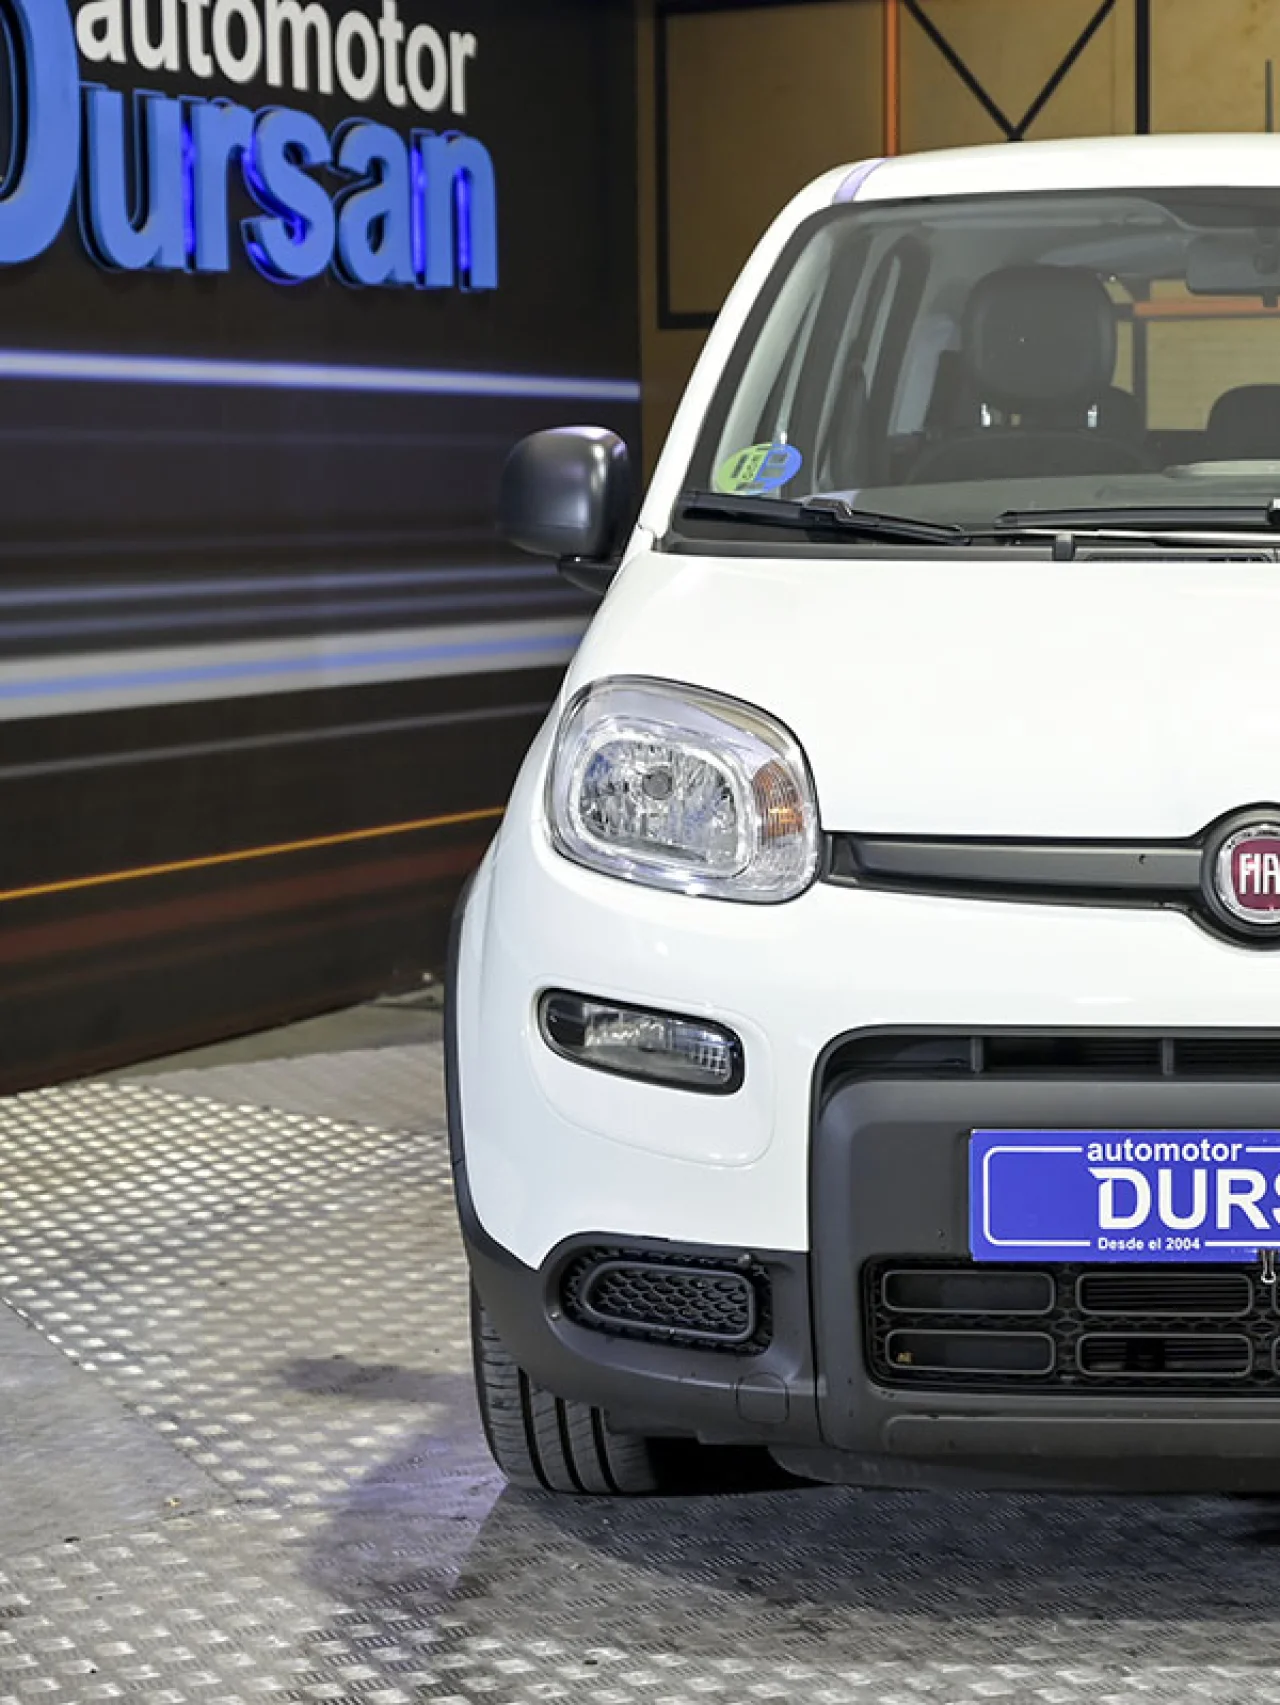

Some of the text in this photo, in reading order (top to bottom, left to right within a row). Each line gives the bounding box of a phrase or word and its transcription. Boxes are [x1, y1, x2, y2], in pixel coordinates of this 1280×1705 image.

[76, 0, 477, 115] automotor
[1087, 1138, 1243, 1162] automotor
[1098, 1237, 1201, 1250] Desde el 2004
